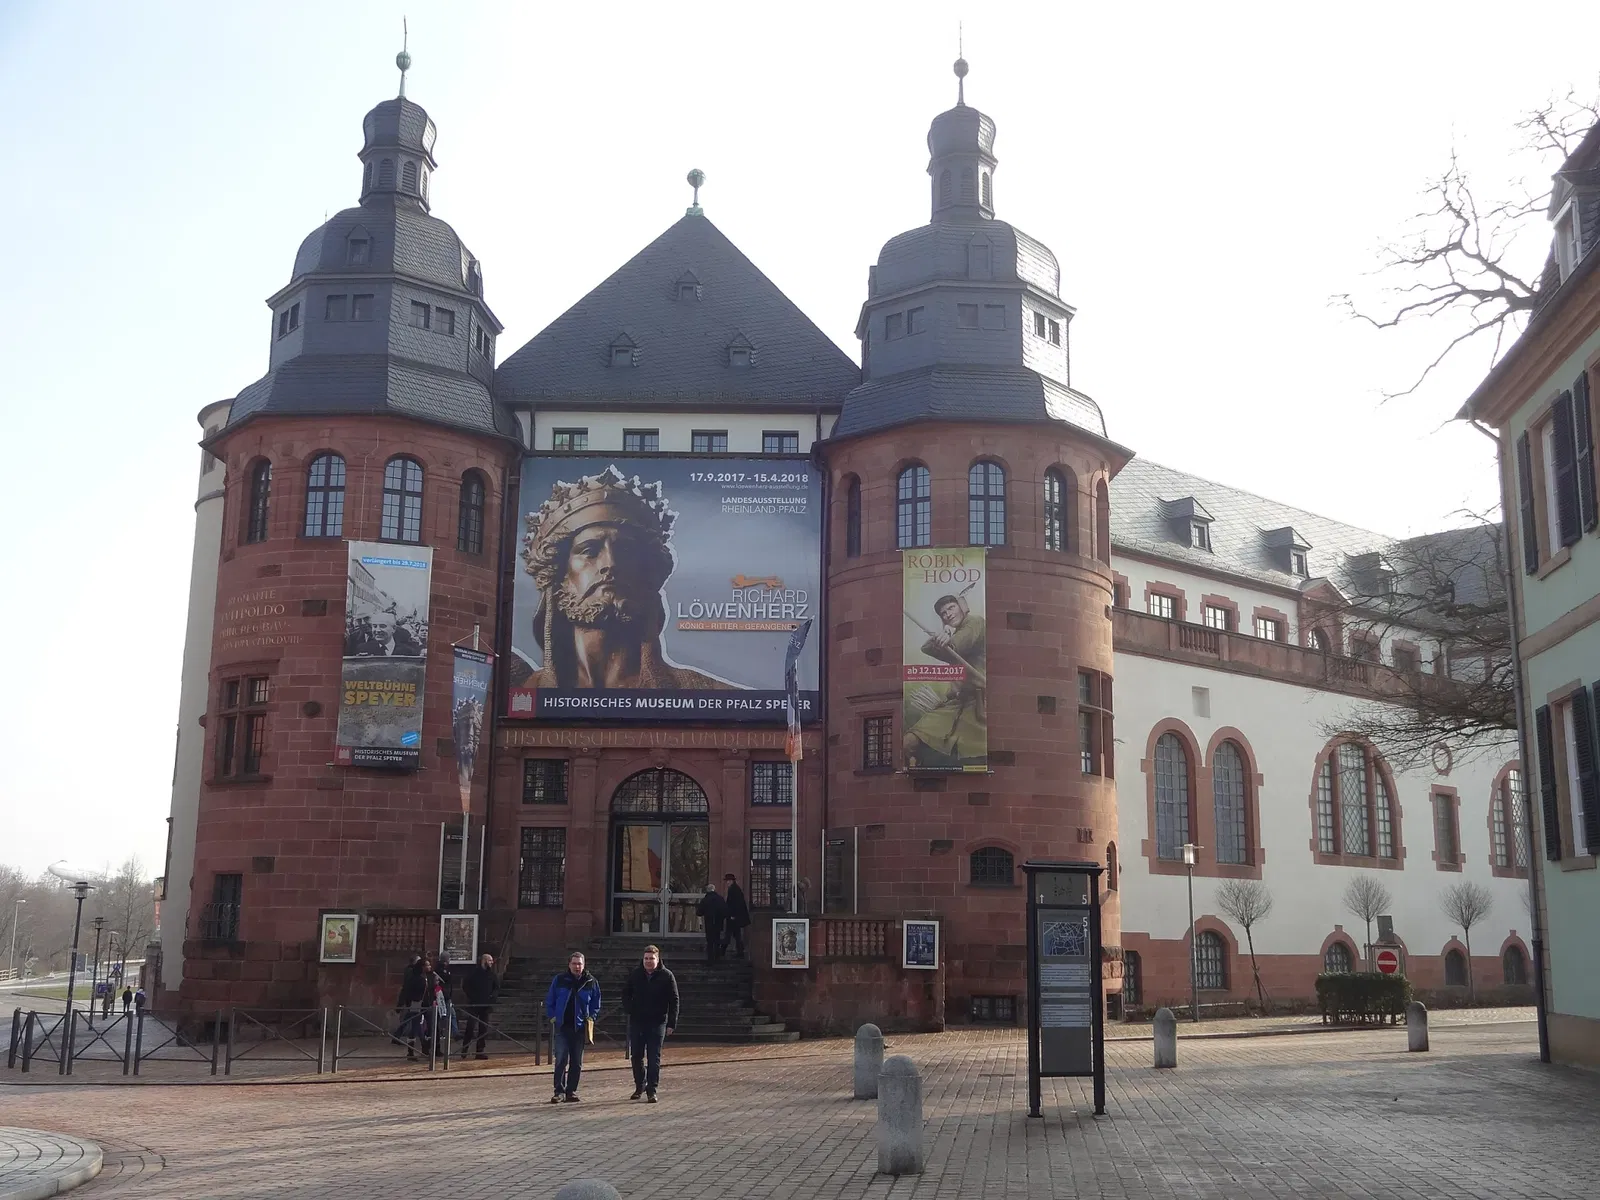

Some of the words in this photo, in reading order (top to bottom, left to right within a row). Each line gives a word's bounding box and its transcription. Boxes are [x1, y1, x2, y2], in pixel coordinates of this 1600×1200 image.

[690, 473, 745, 481] 17.9.2017
[754, 474, 808, 482] 15.4.2018
[721, 505, 806, 514] RHEINLAND-PFALZ
[908, 554, 965, 568] ROBIN
[924, 569, 981, 583] HOOD
[732, 589, 808, 603] RICHARD
[677, 599, 808, 619] LÖWENHERZ
[680, 621, 704, 630] KÖNIG
[907, 666, 918, 675] ab
[919, 666, 964, 675] 12.11.2017
[345, 680, 416, 692] WELTBÜHNE
[344, 691, 416, 706] SPEYER
[544, 697, 632, 707] HISTORISCHES
[635, 698, 694, 708] MUSEUM
[698, 699, 722, 708] DER
[726, 699, 762, 709] PFALZ
[766, 699, 811, 709] SPEER
[1082, 894, 1087, 904] 5
[1082, 917, 1088, 927] 5
